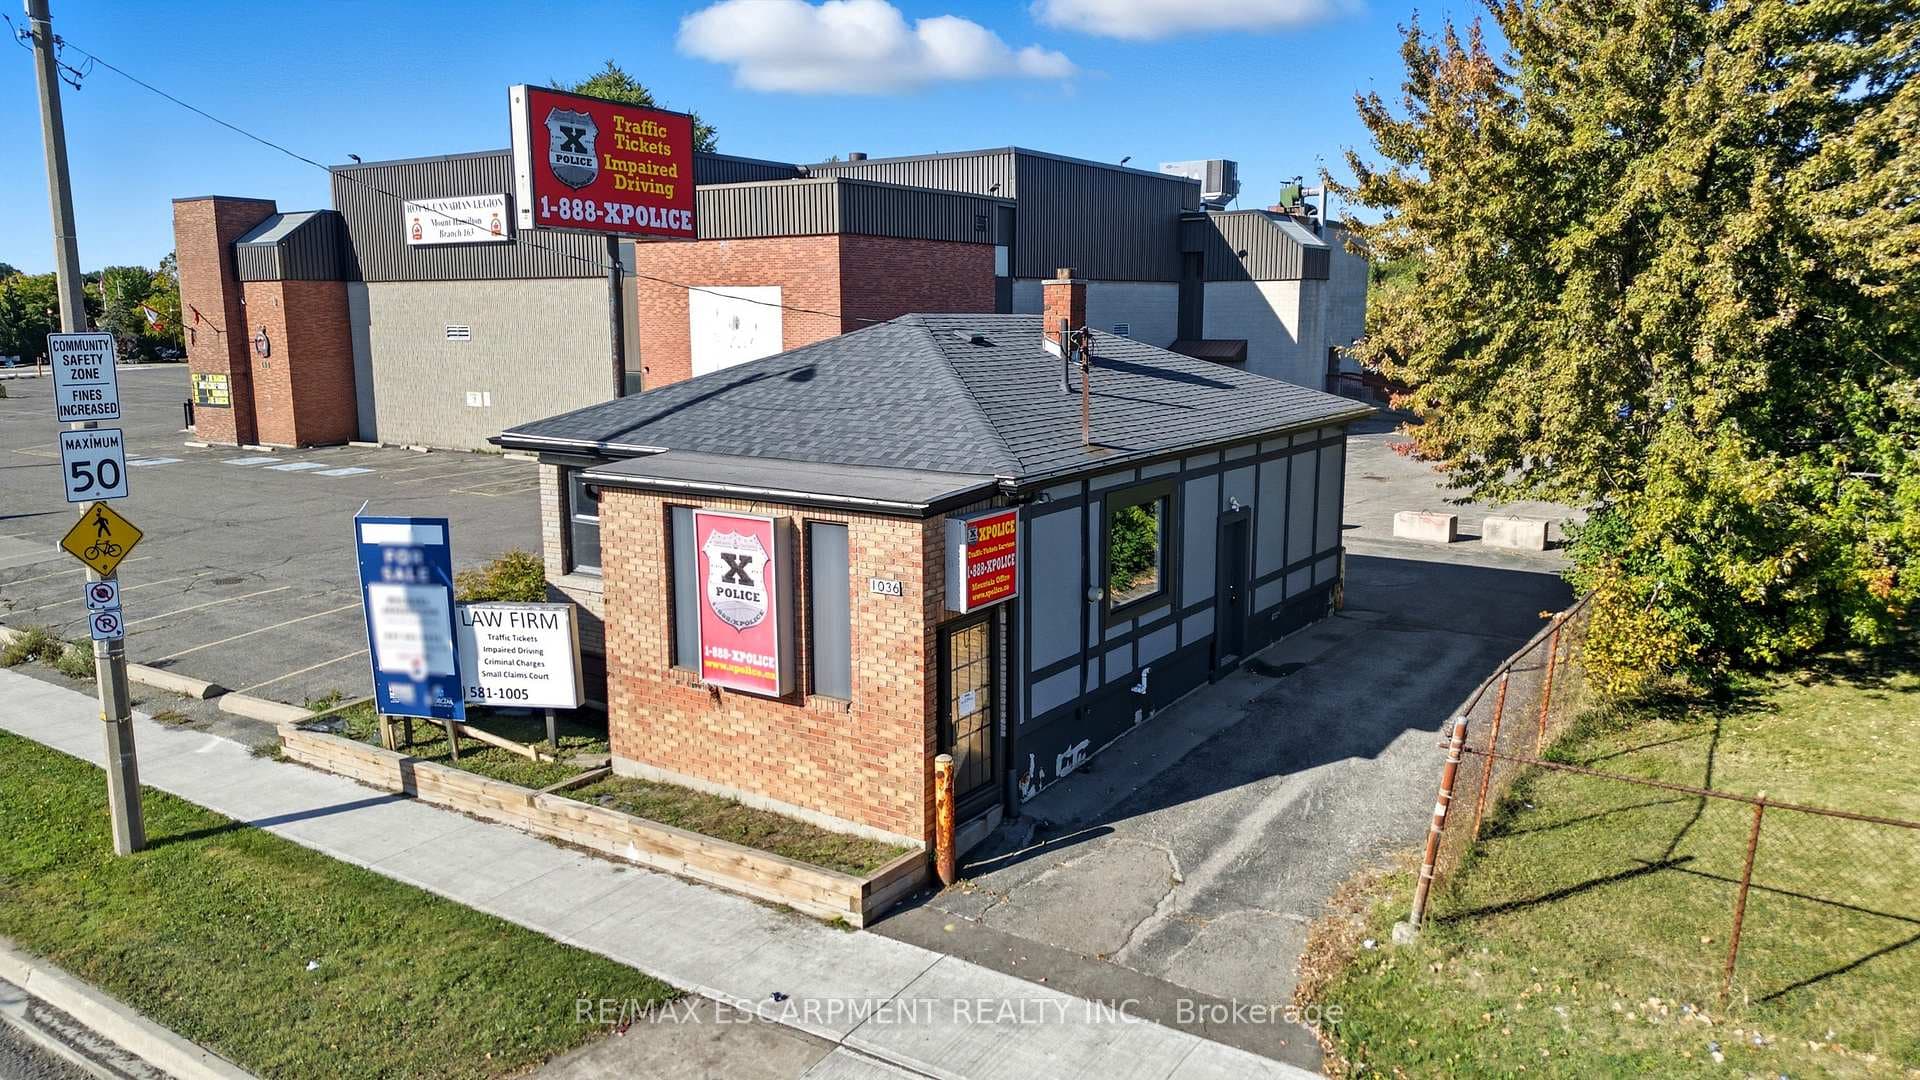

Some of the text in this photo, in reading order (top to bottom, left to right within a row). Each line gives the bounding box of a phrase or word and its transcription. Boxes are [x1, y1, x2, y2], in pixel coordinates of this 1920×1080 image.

[613, 115, 667, 138] Traffic
[560, 125, 587, 154] X
[615, 133, 672, 156] Tickets
[556, 154, 592, 167] POLICE
[604, 154, 678, 178] Impaired
[613, 173, 674, 199] Driving
[432, 200, 471, 211] CANADIAN
[473, 198, 503, 209] LEGION
[541, 195, 692, 231] 1-888-XPOLICE
[431, 218, 451, 227] Mount
[439, 229, 462, 238] Branch
[52, 339, 110, 353] COMMUNITY
[63, 354, 104, 367] SAFETY
[71, 368, 100, 380] ZONE
[73, 389, 102, 401] FINES
[60, 402, 117, 416] INCREASED
[65, 437, 119, 450] MAXIMUM
[72, 458, 120, 492] 50
[979, 520, 1015, 541] XPOLICE
[720, 552, 755, 587] X
[967, 553, 1015, 578] 1-888-XPOLICE
[872, 579, 899, 594] 1036
[716, 586, 760, 602] POLICE
[461, 610, 502, 627] LAW
[510, 611, 558, 630] FIRM
[487, 633, 538, 643] Traffic Tickets
[483, 646, 544, 656] Impaired Driving
[704, 645, 775, 668] 1-888-XPOLICE
[484, 658, 545, 668] Criminal Charges
[481, 670, 549, 680] Small Claims Court
[470, 686, 529, 700] 581-1005
